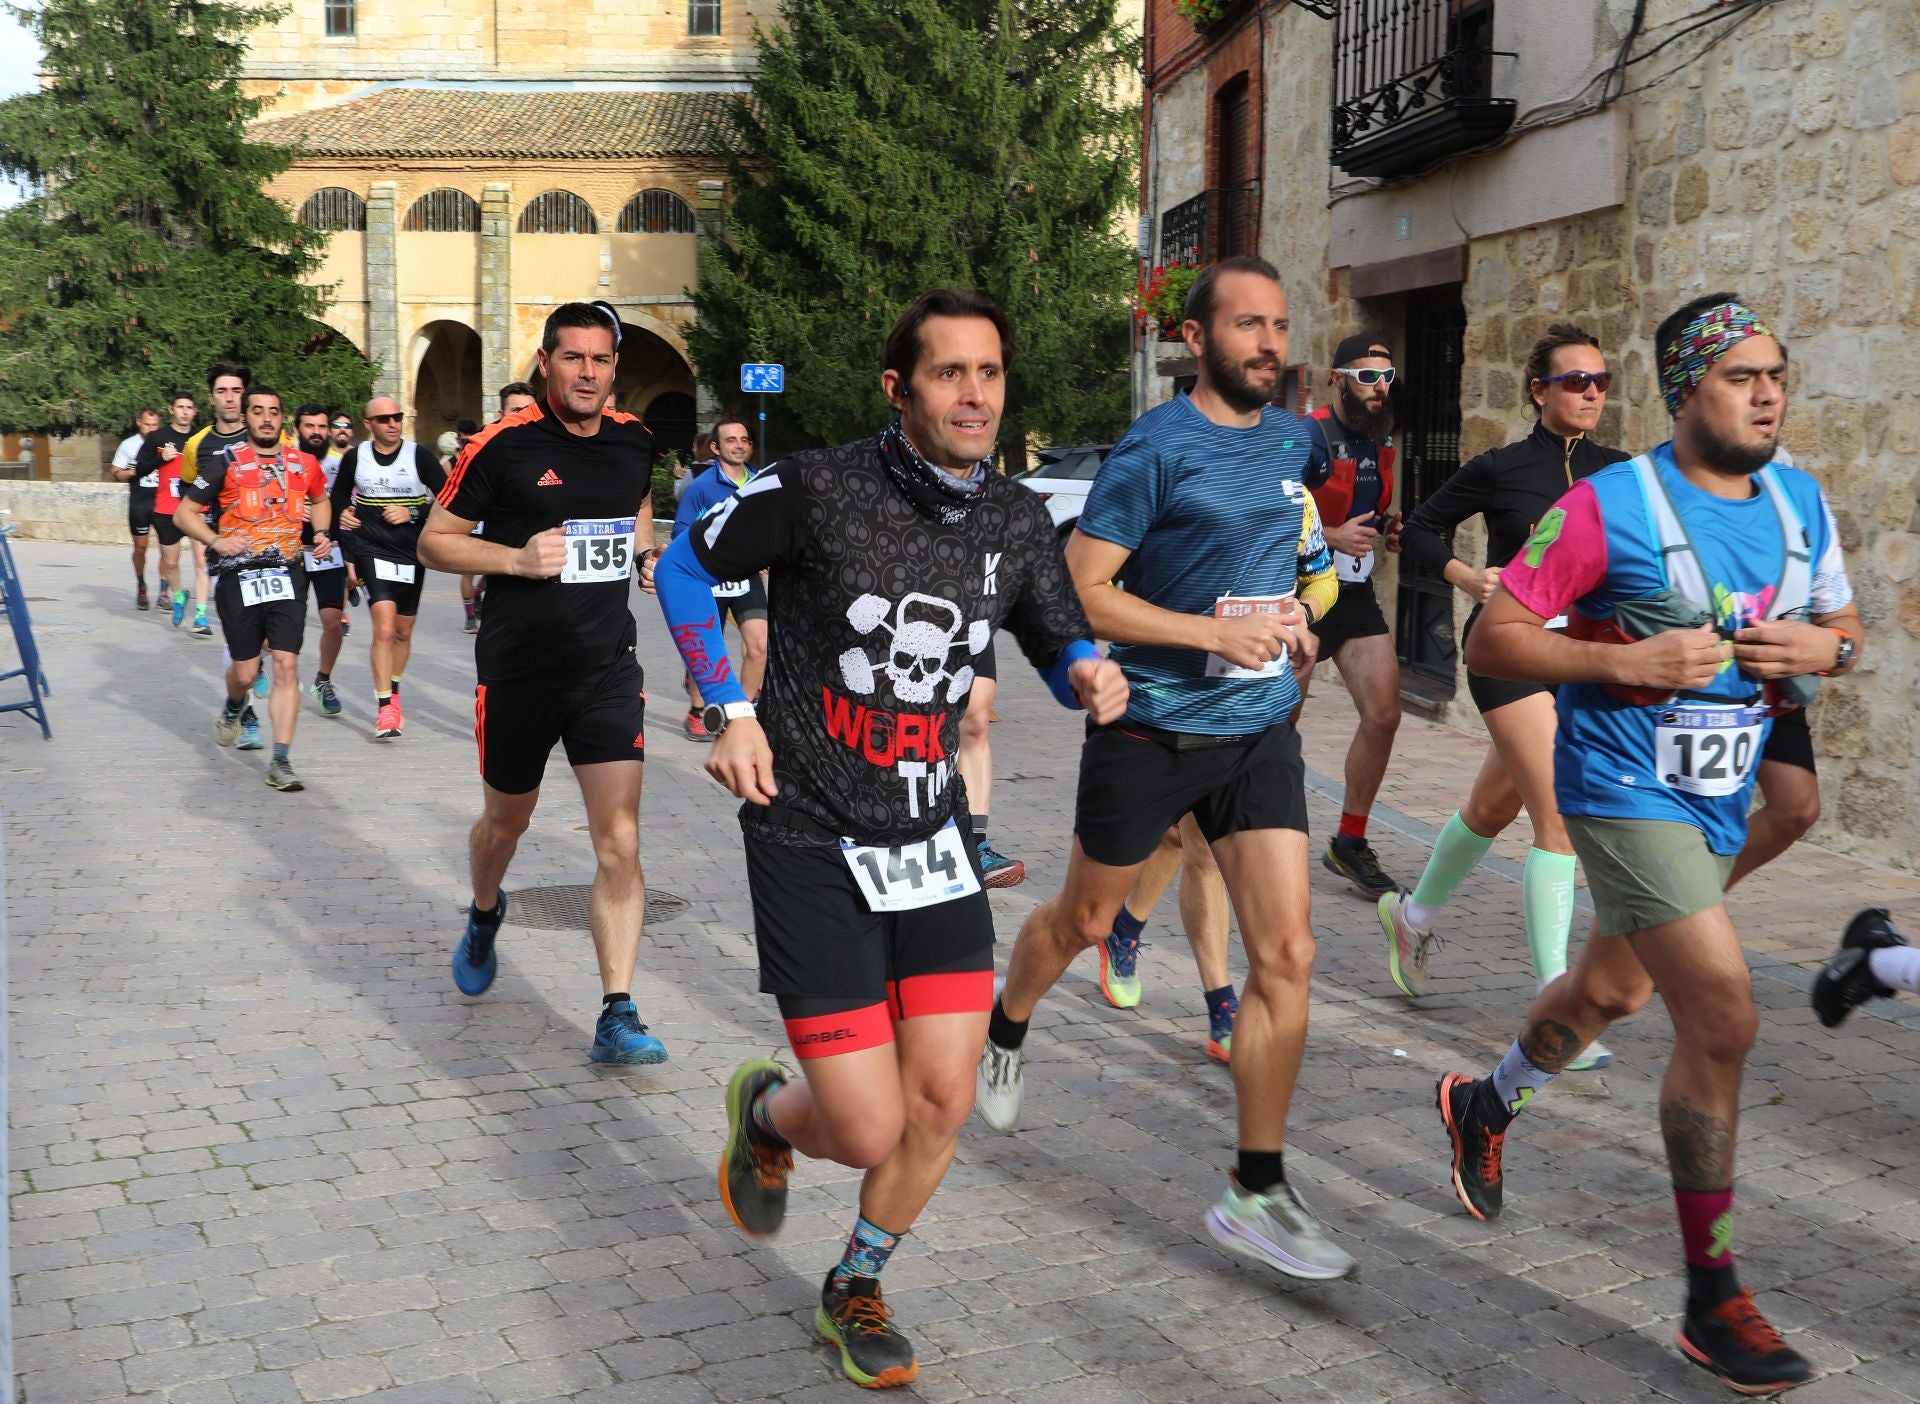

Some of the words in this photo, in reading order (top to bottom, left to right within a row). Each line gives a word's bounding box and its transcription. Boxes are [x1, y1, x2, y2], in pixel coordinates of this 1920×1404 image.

[537, 479, 563, 487] adidas
[566, 524, 589, 534] ASTU
[572, 537, 627, 571] 135
[250, 577, 284, 597] 119
[983, 552, 1003, 596] K
[822, 686, 948, 768] WORK
[1673, 732, 1750, 780] 120
[856, 839, 957, 895] 144
